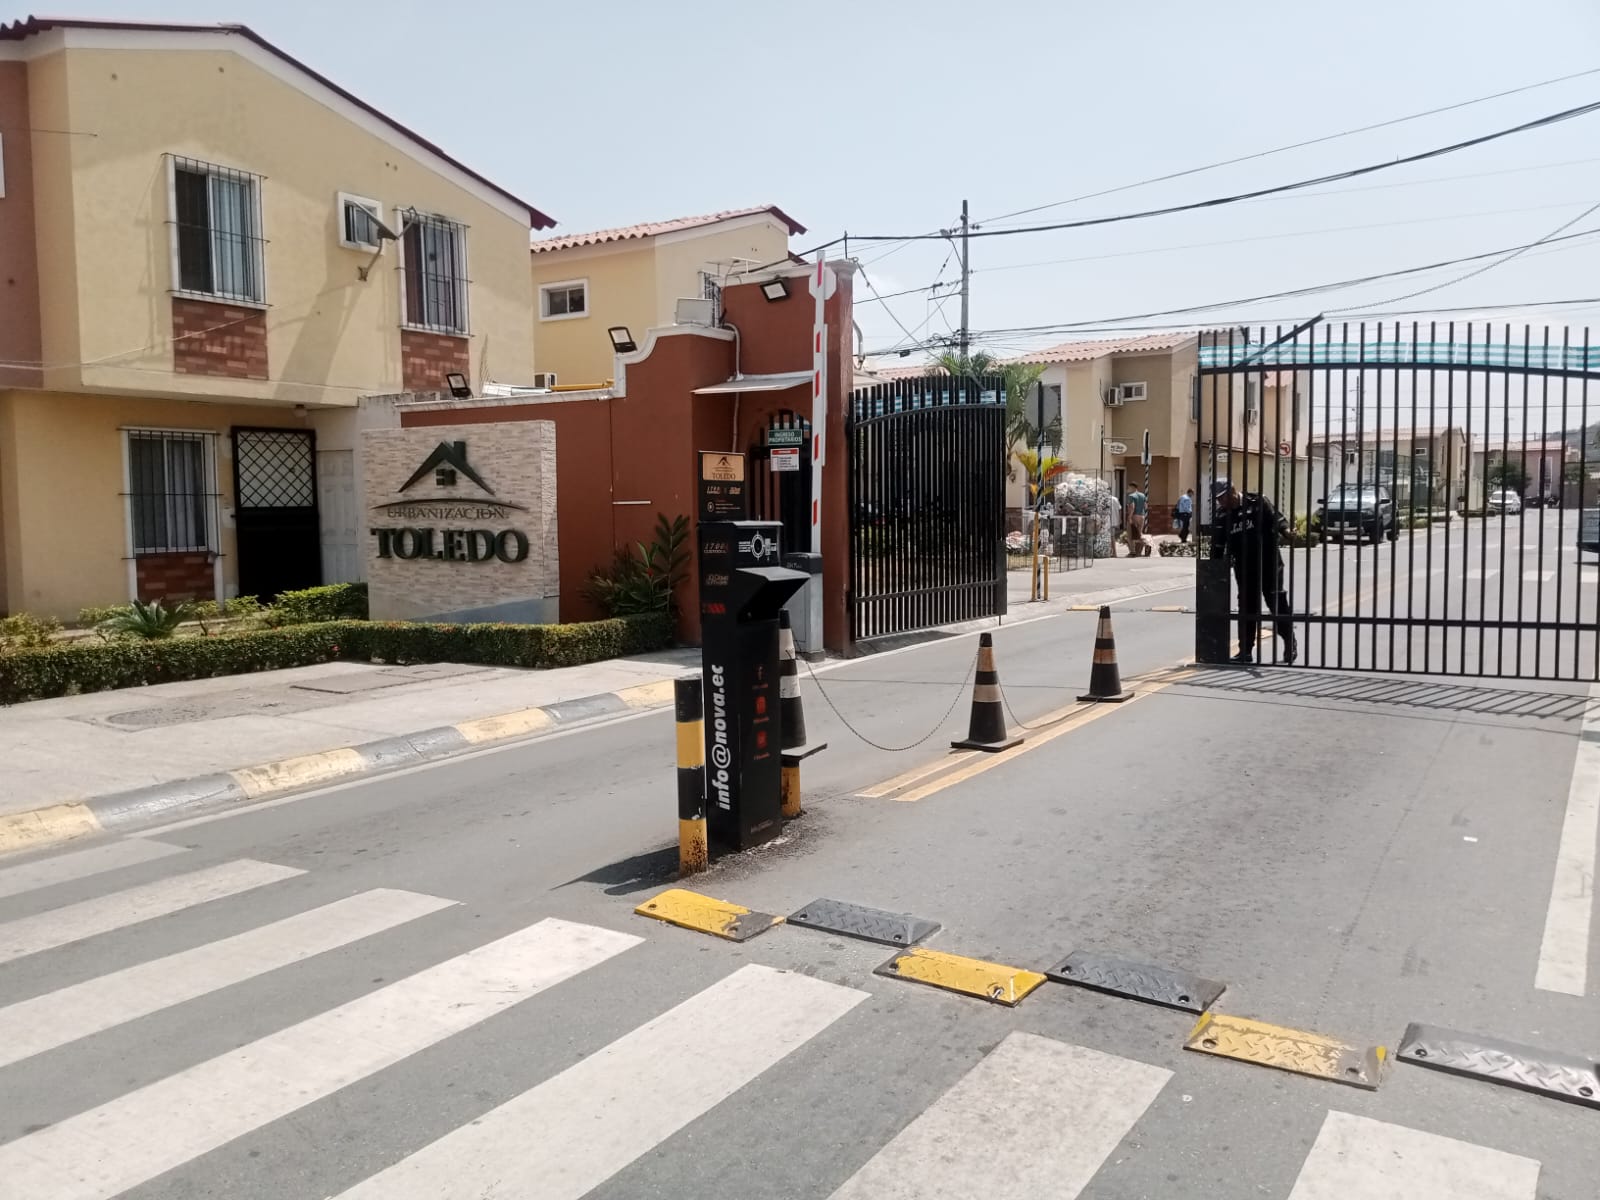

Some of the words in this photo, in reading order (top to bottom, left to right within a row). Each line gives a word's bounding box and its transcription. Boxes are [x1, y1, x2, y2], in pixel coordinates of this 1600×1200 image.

[712, 472, 736, 480] TOLEDO
[370, 527, 529, 563] TOLEDO
[711, 664, 731, 810] info@nova.ec
